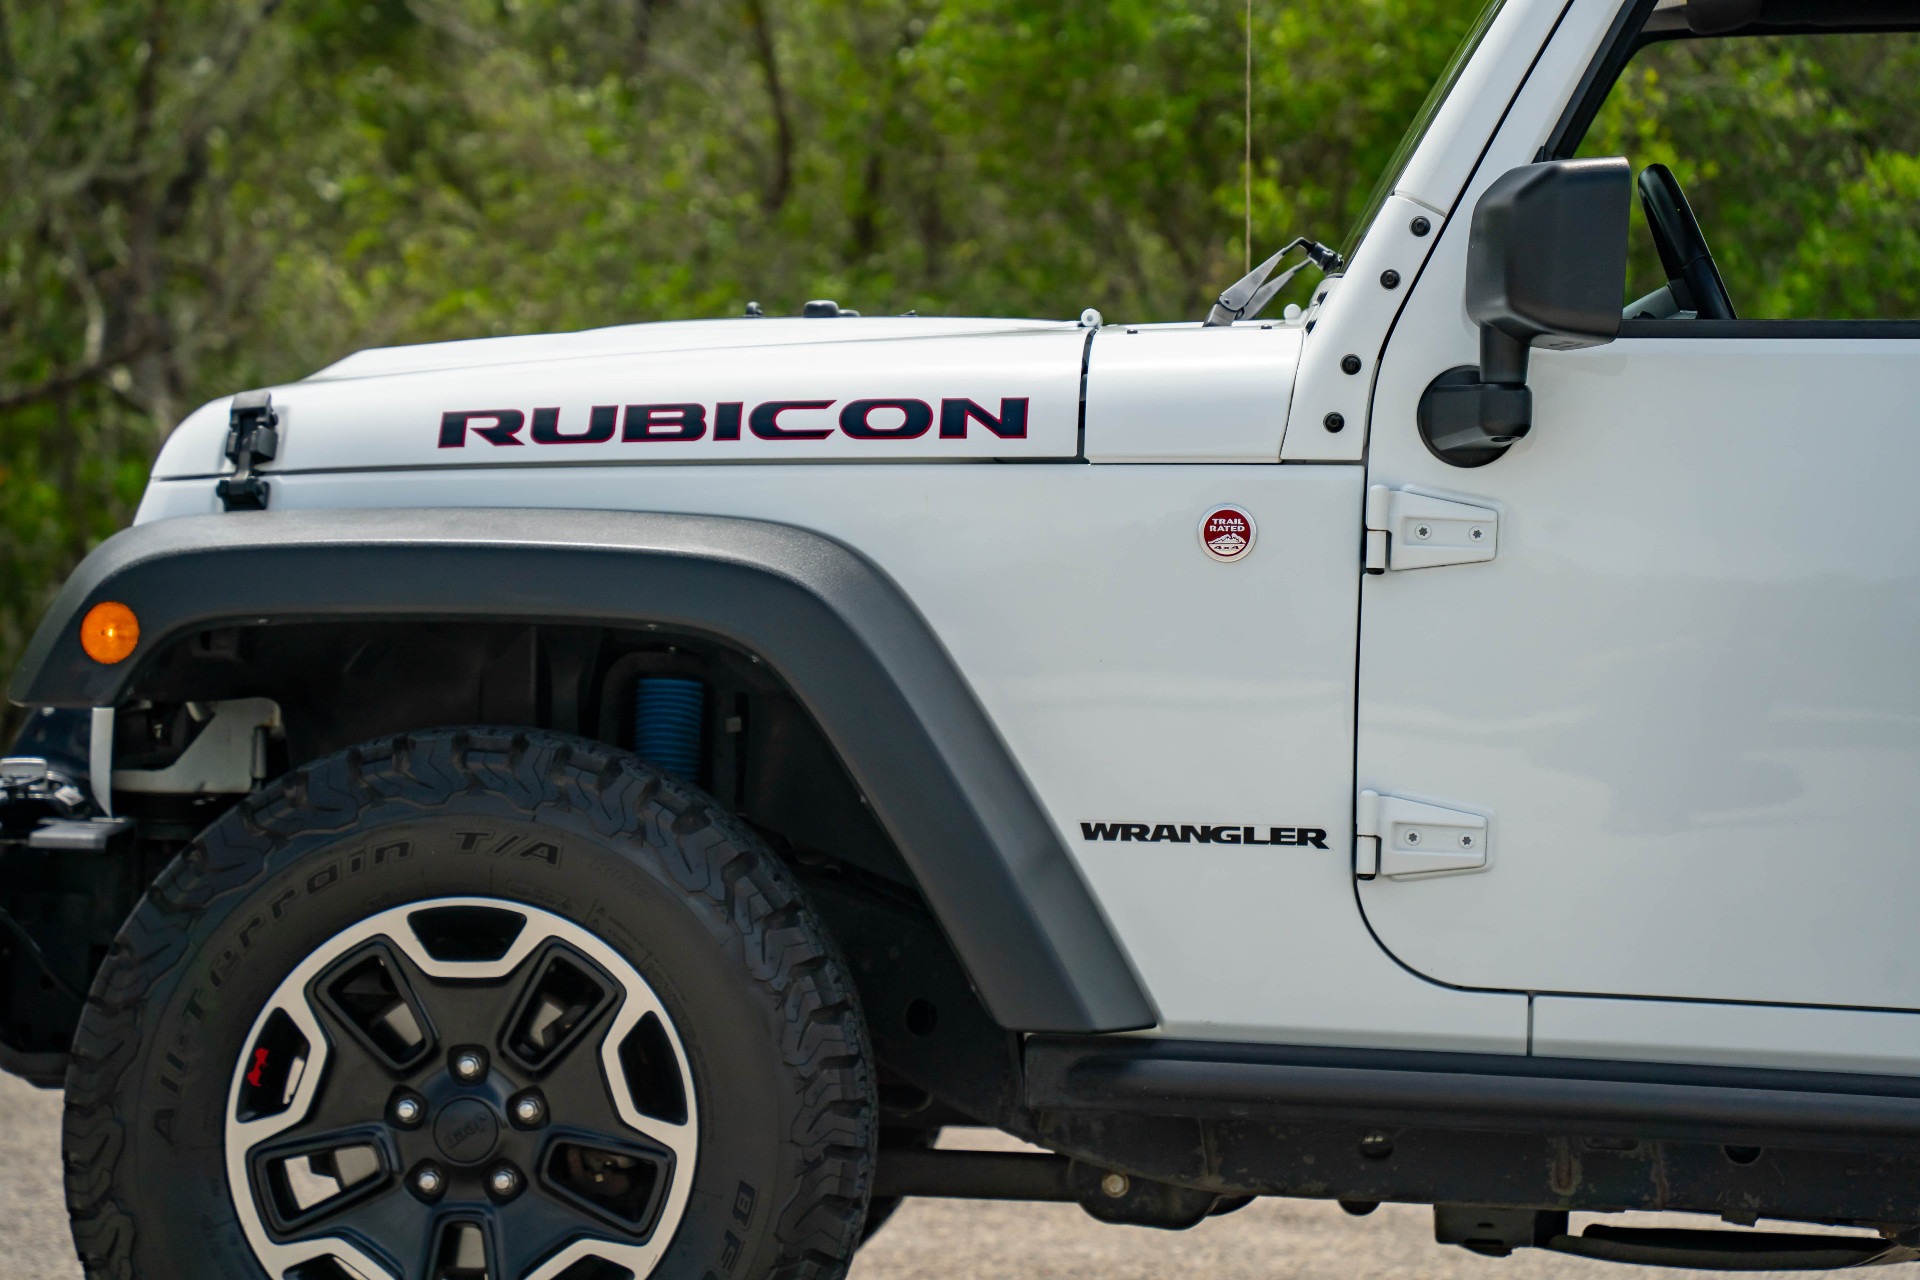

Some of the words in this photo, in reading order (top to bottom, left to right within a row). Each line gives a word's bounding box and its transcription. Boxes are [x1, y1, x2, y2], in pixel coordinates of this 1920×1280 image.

[437, 397, 1029, 448] RUBICON
[451, 830, 565, 870] T/A
[1079, 822, 1330, 850] WRANGLER
[701, 1179, 760, 1280] BF
